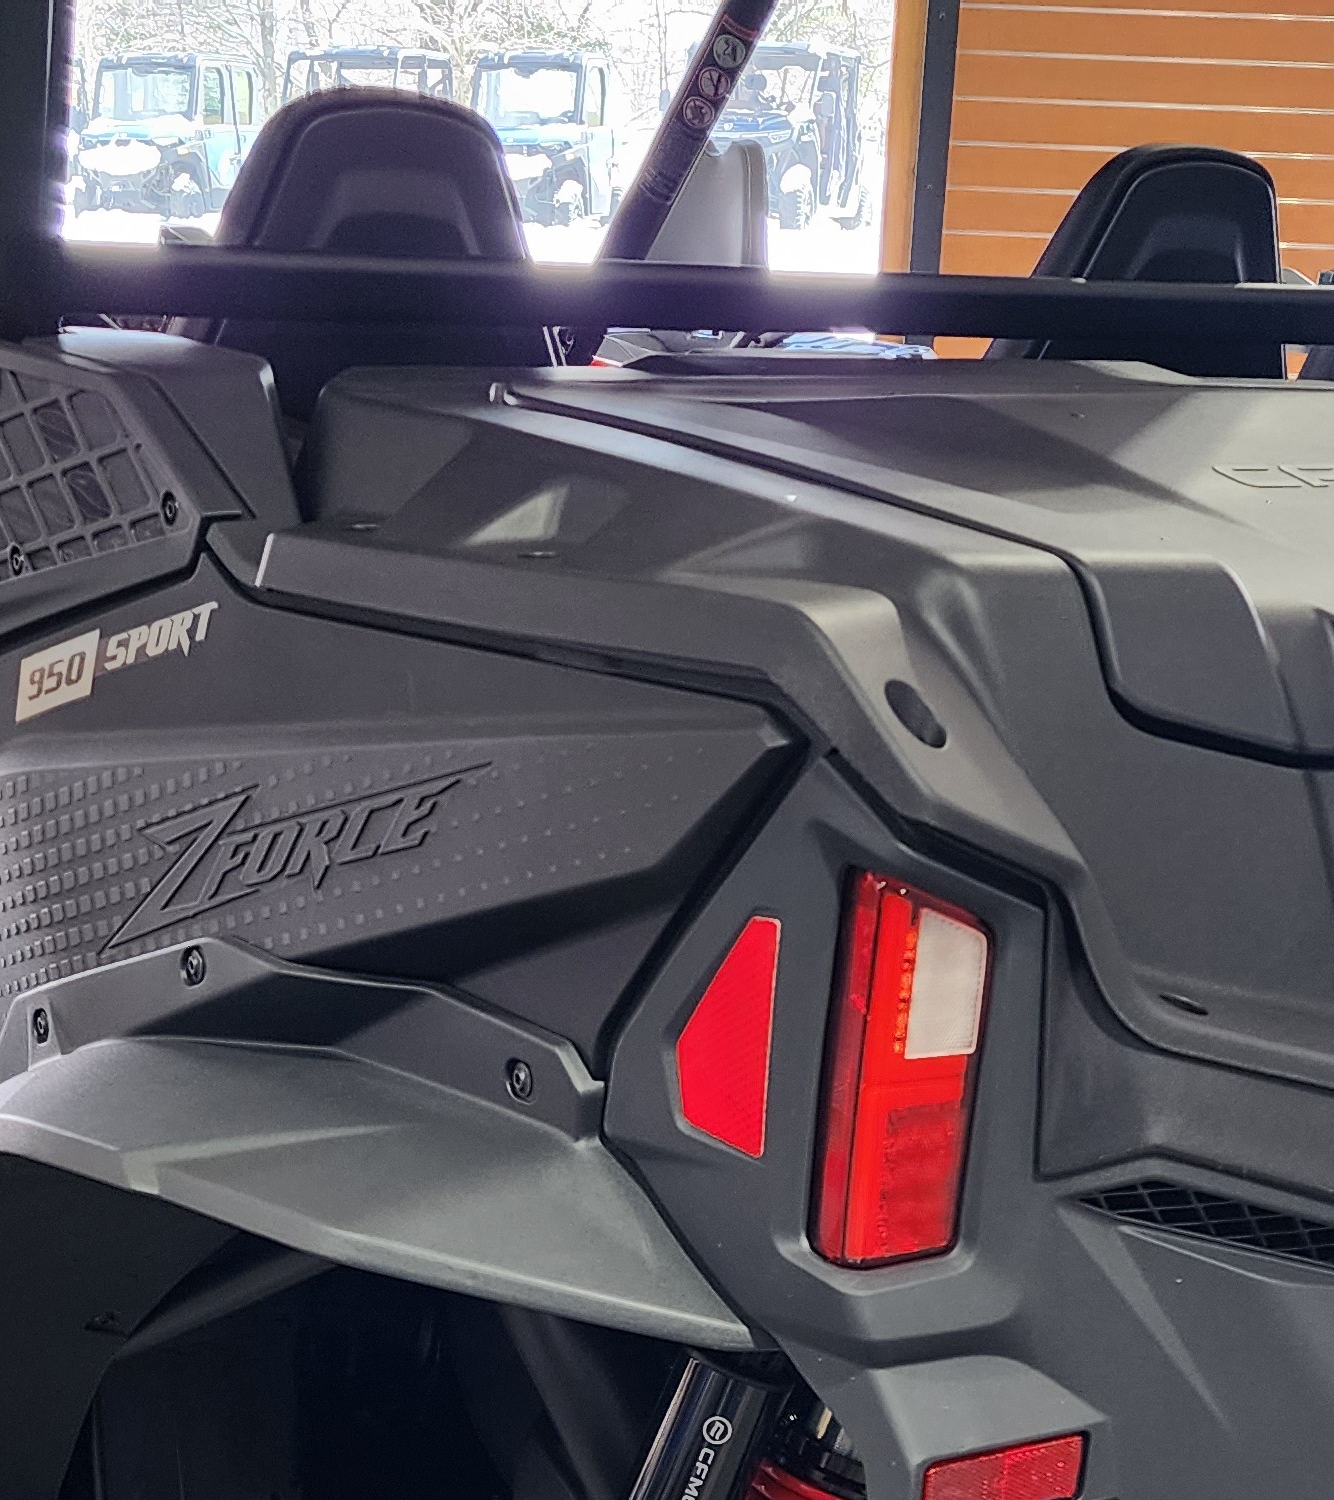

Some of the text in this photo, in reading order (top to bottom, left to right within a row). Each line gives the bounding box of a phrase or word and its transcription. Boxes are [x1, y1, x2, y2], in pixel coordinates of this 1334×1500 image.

[27, 600, 220, 701] 950 SPORT
[98, 761, 495, 957] ZFORCE
